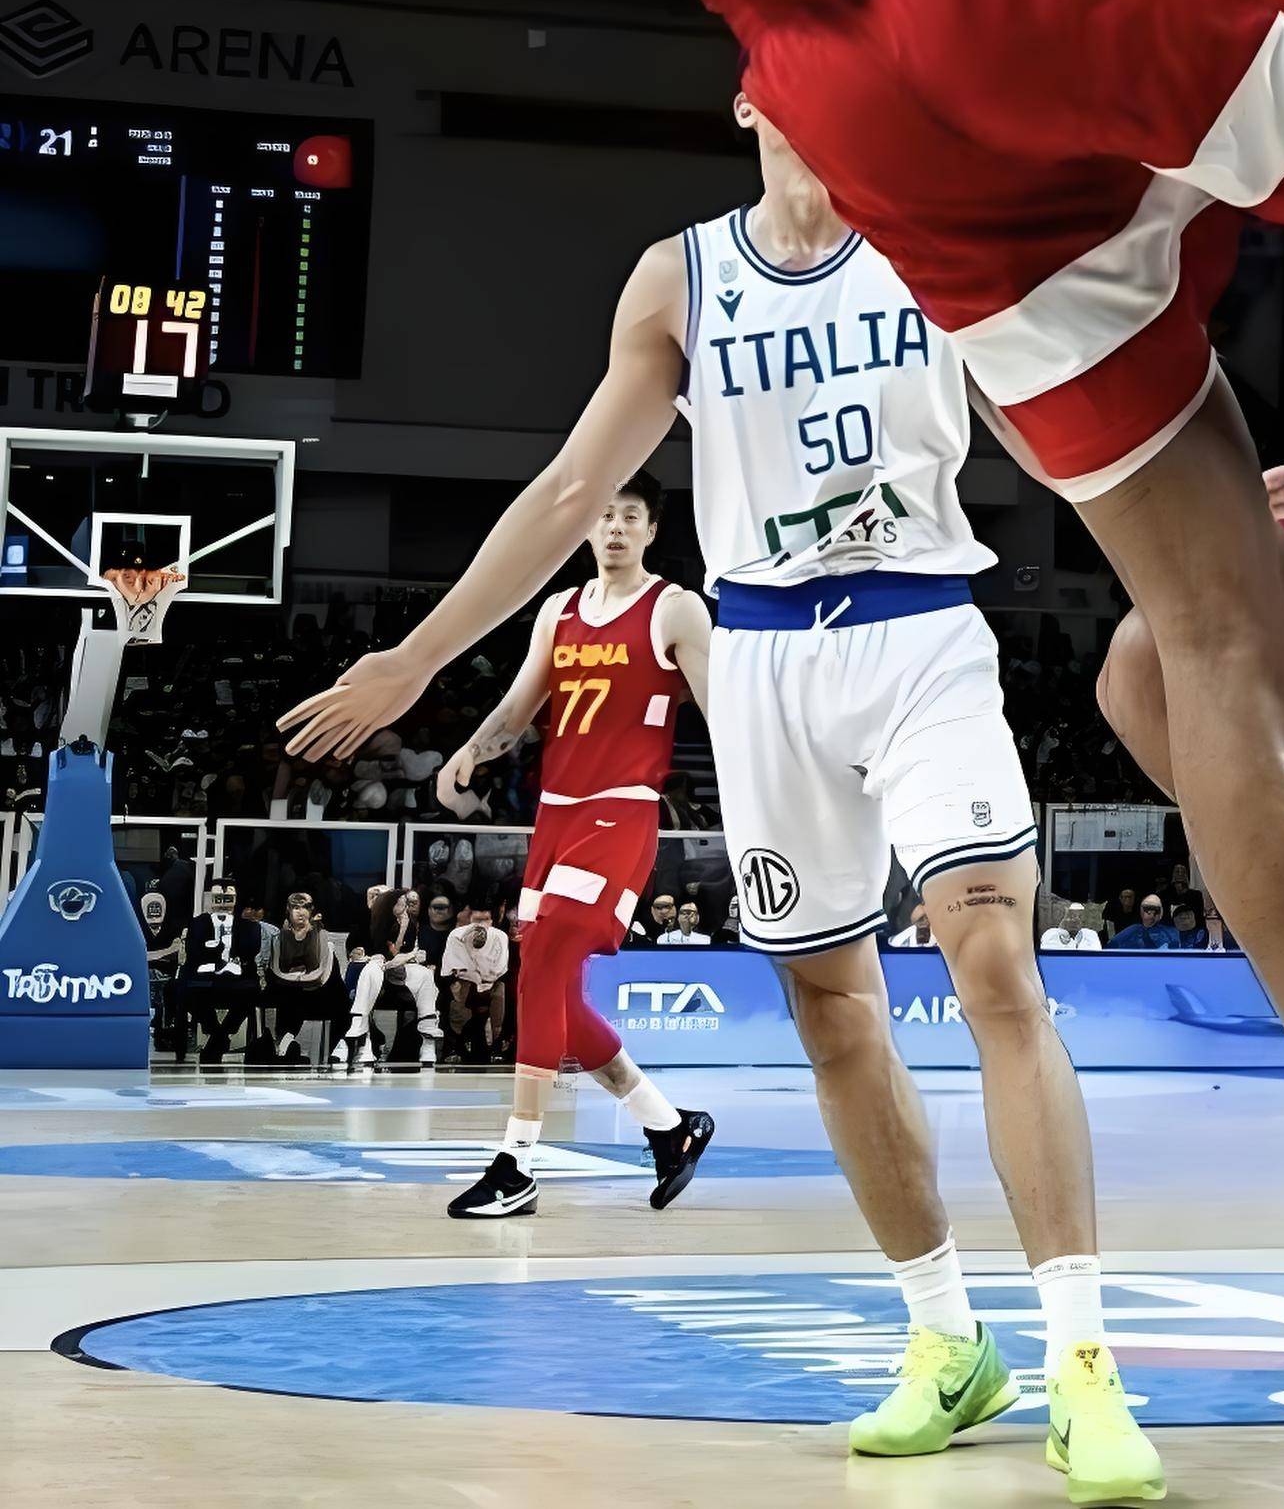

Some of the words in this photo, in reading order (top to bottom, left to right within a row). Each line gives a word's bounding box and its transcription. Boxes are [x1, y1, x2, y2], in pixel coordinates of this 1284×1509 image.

[119, 23, 355, 88] ARENA
[38, 128, 72, 156] 21
[709, 307, 929, 397] ITALIA
[798, 403, 873, 475] 50
[556, 678, 612, 738] 77
[617, 982, 726, 1013] ITA
